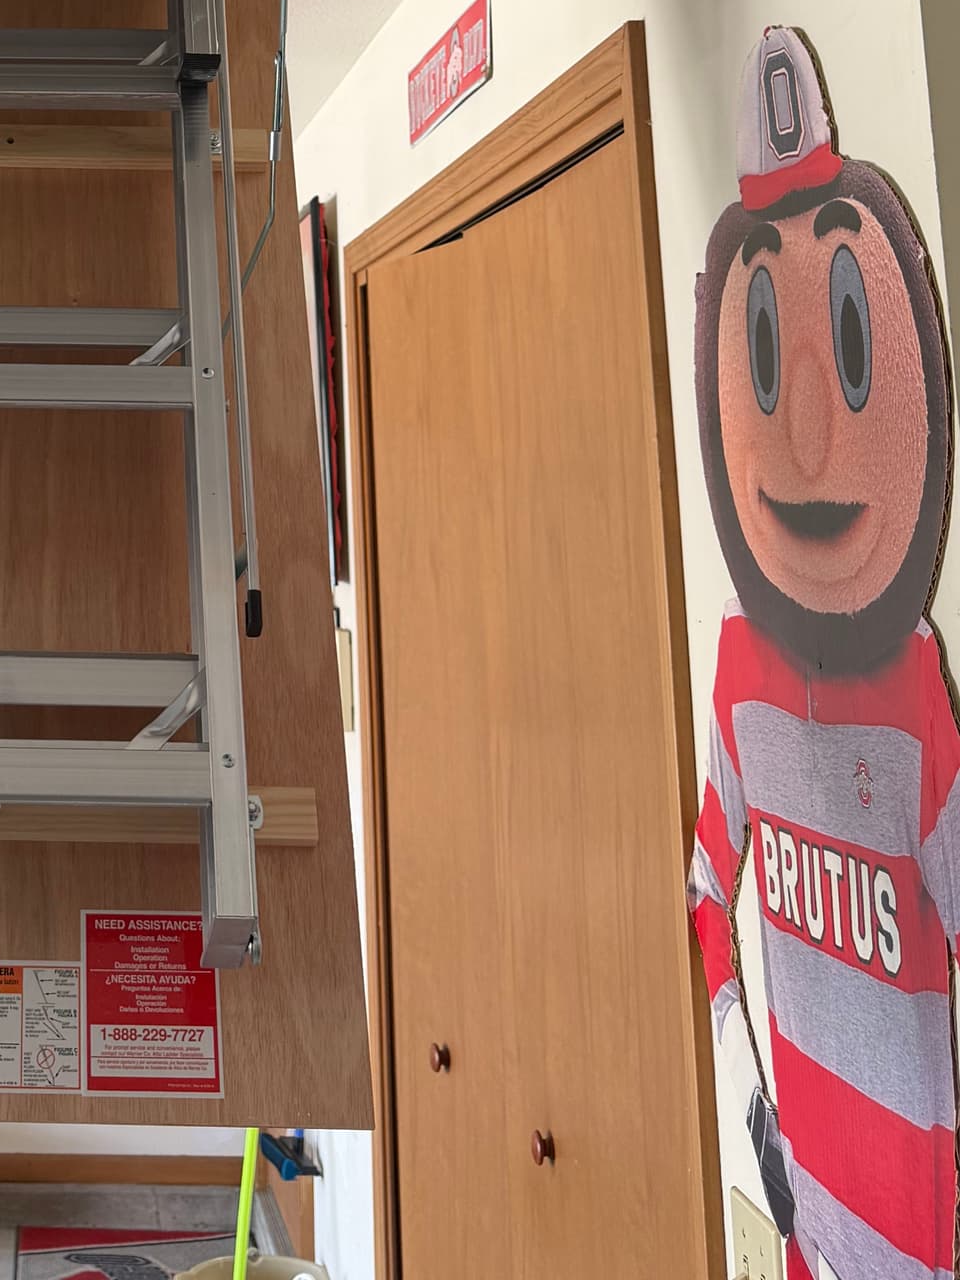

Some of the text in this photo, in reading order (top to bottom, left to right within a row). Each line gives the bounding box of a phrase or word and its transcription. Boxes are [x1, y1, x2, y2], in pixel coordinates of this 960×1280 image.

[759, 817, 902, 978] BRUTUS
[95, 919, 203, 932] NEED ASSISTANCE?
[119, 934, 181, 942] Questions About:
[133, 954, 168, 962] Operation
[115, 962, 147, 971] Damages
[159, 962, 187, 970] Returns
[105, 975, 197, 985] ¿NECESITA AYUDA?
[100, 1028, 205, 1042] 1-888-229-7727
